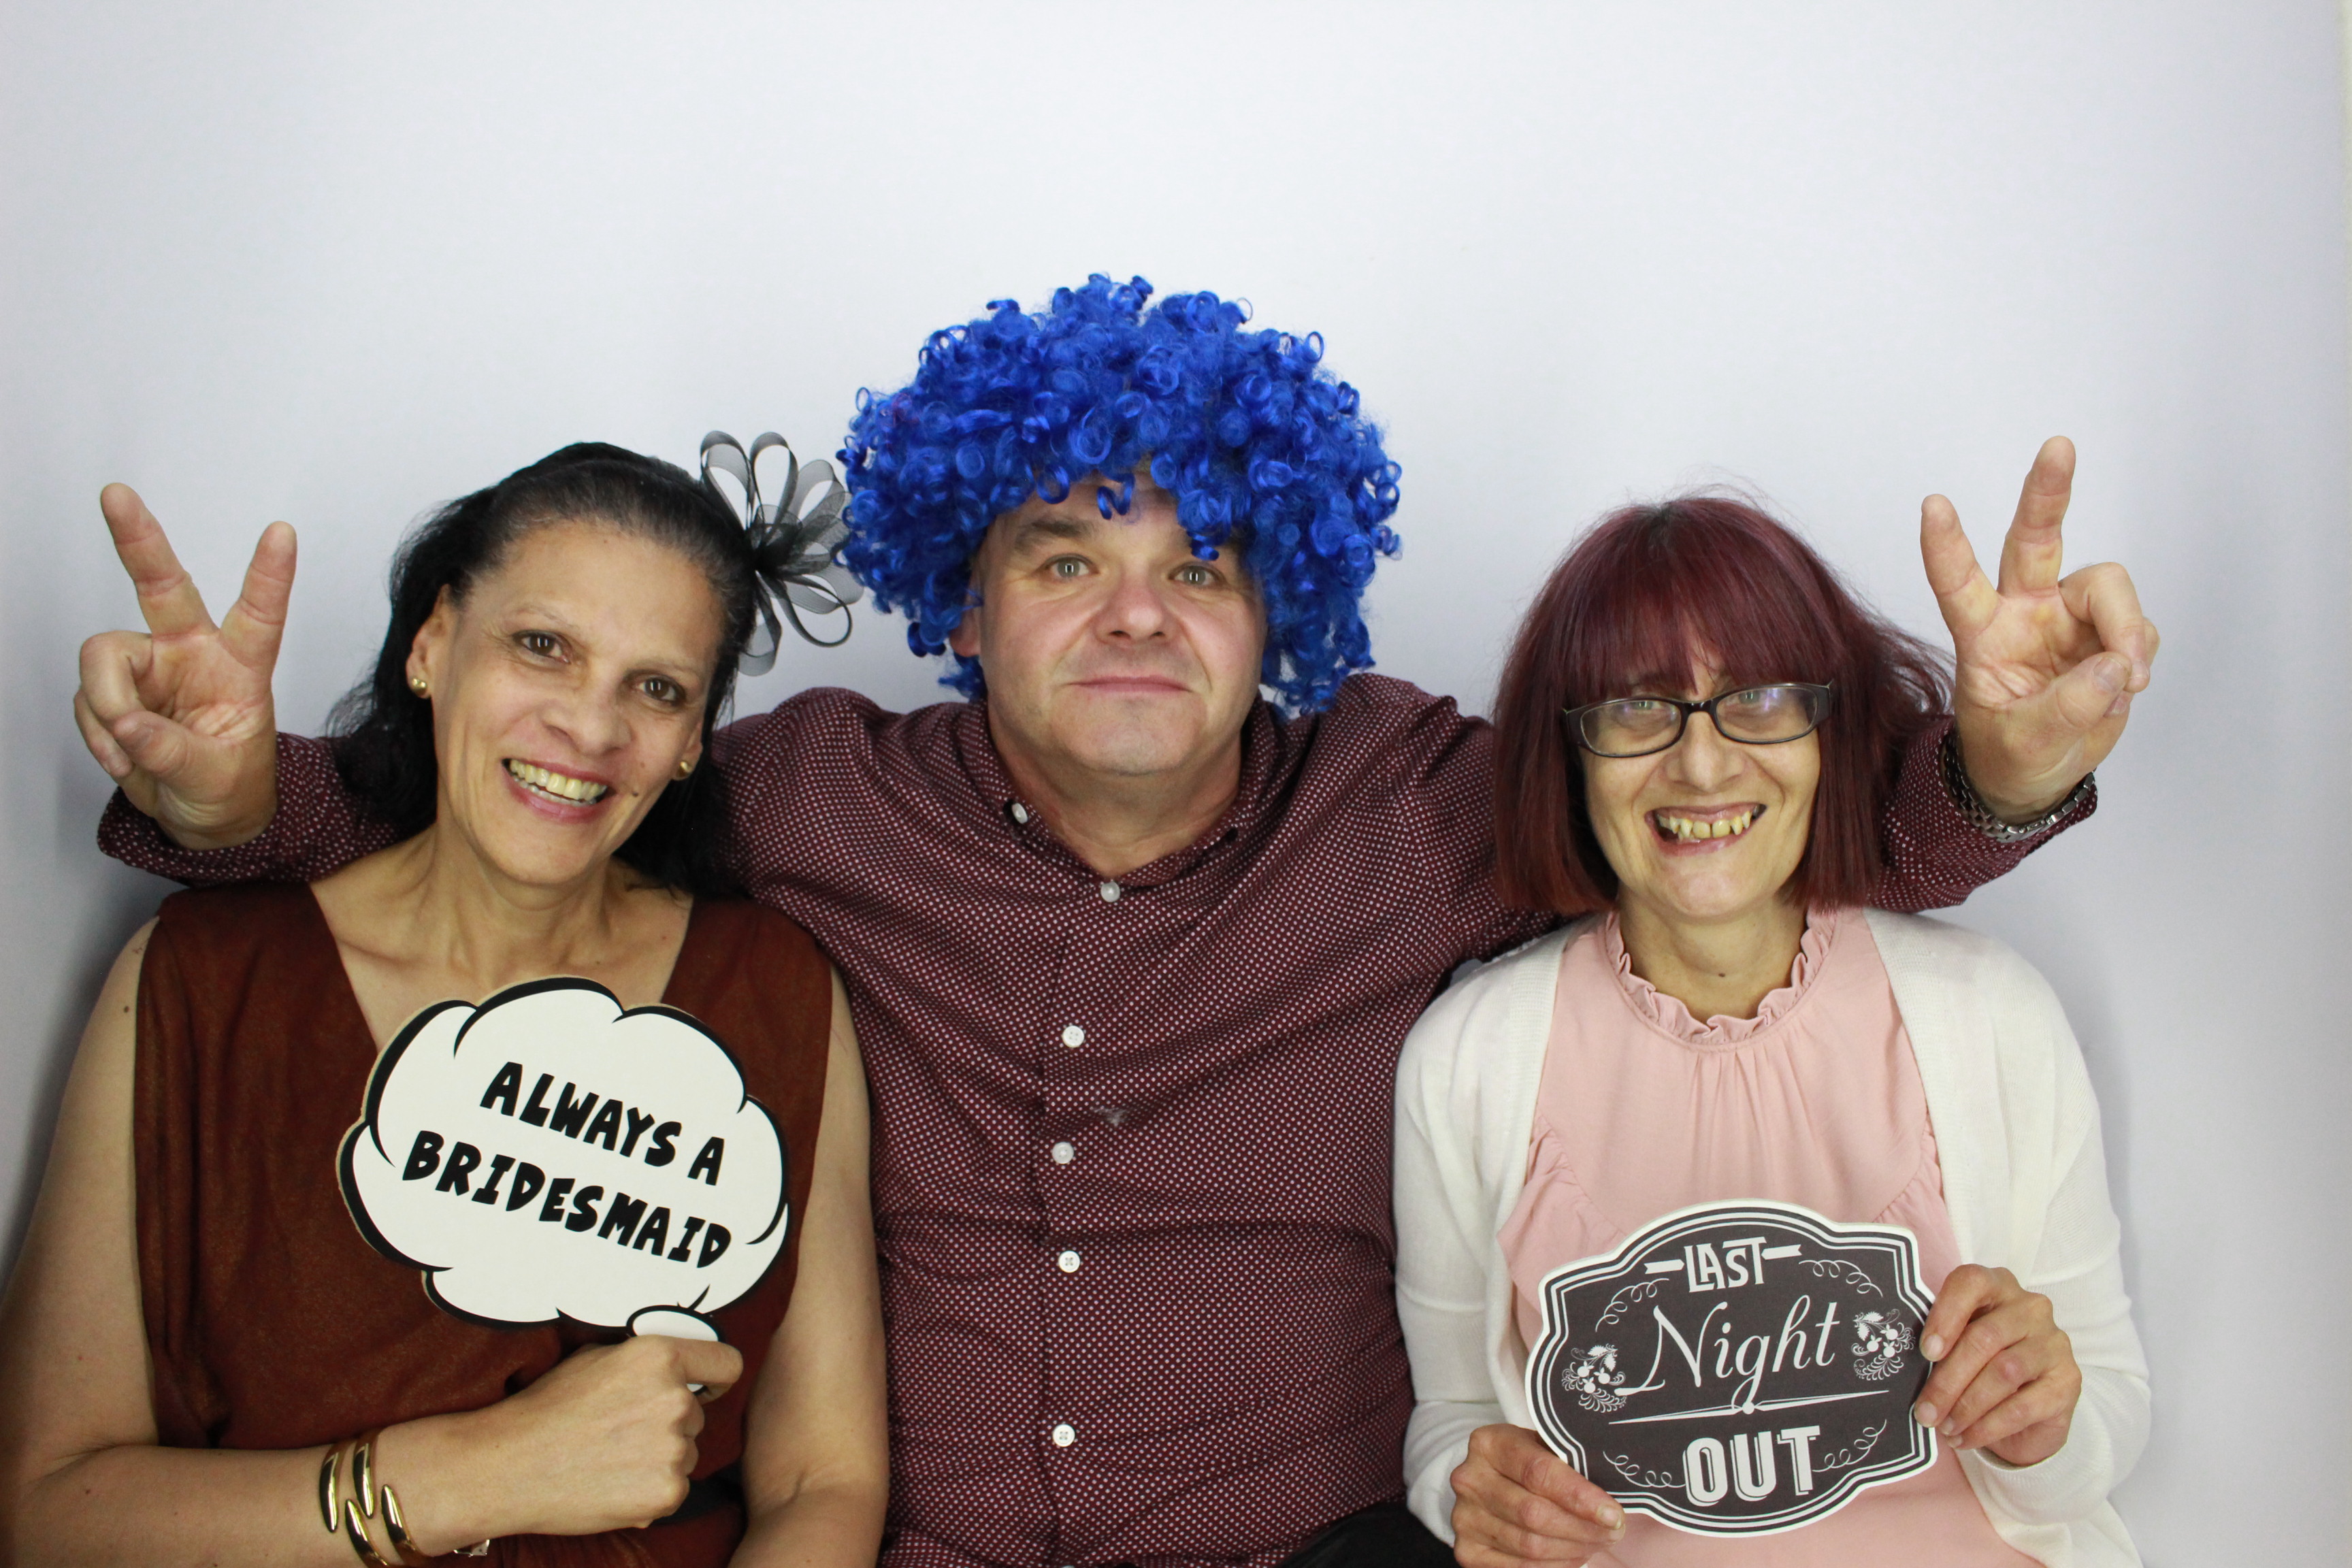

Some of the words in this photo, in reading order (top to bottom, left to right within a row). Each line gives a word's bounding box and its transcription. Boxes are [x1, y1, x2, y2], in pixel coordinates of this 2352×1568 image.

[480, 1062, 682, 1166] ALWAYS
[687, 1137, 725, 1186] A
[402, 1130, 731, 1269] BRIDESMAID
[1684, 1236, 1767, 1293] LAST
[1614, 1294, 1840, 1413] Night
[1682, 1425, 1820, 1507] OUT
